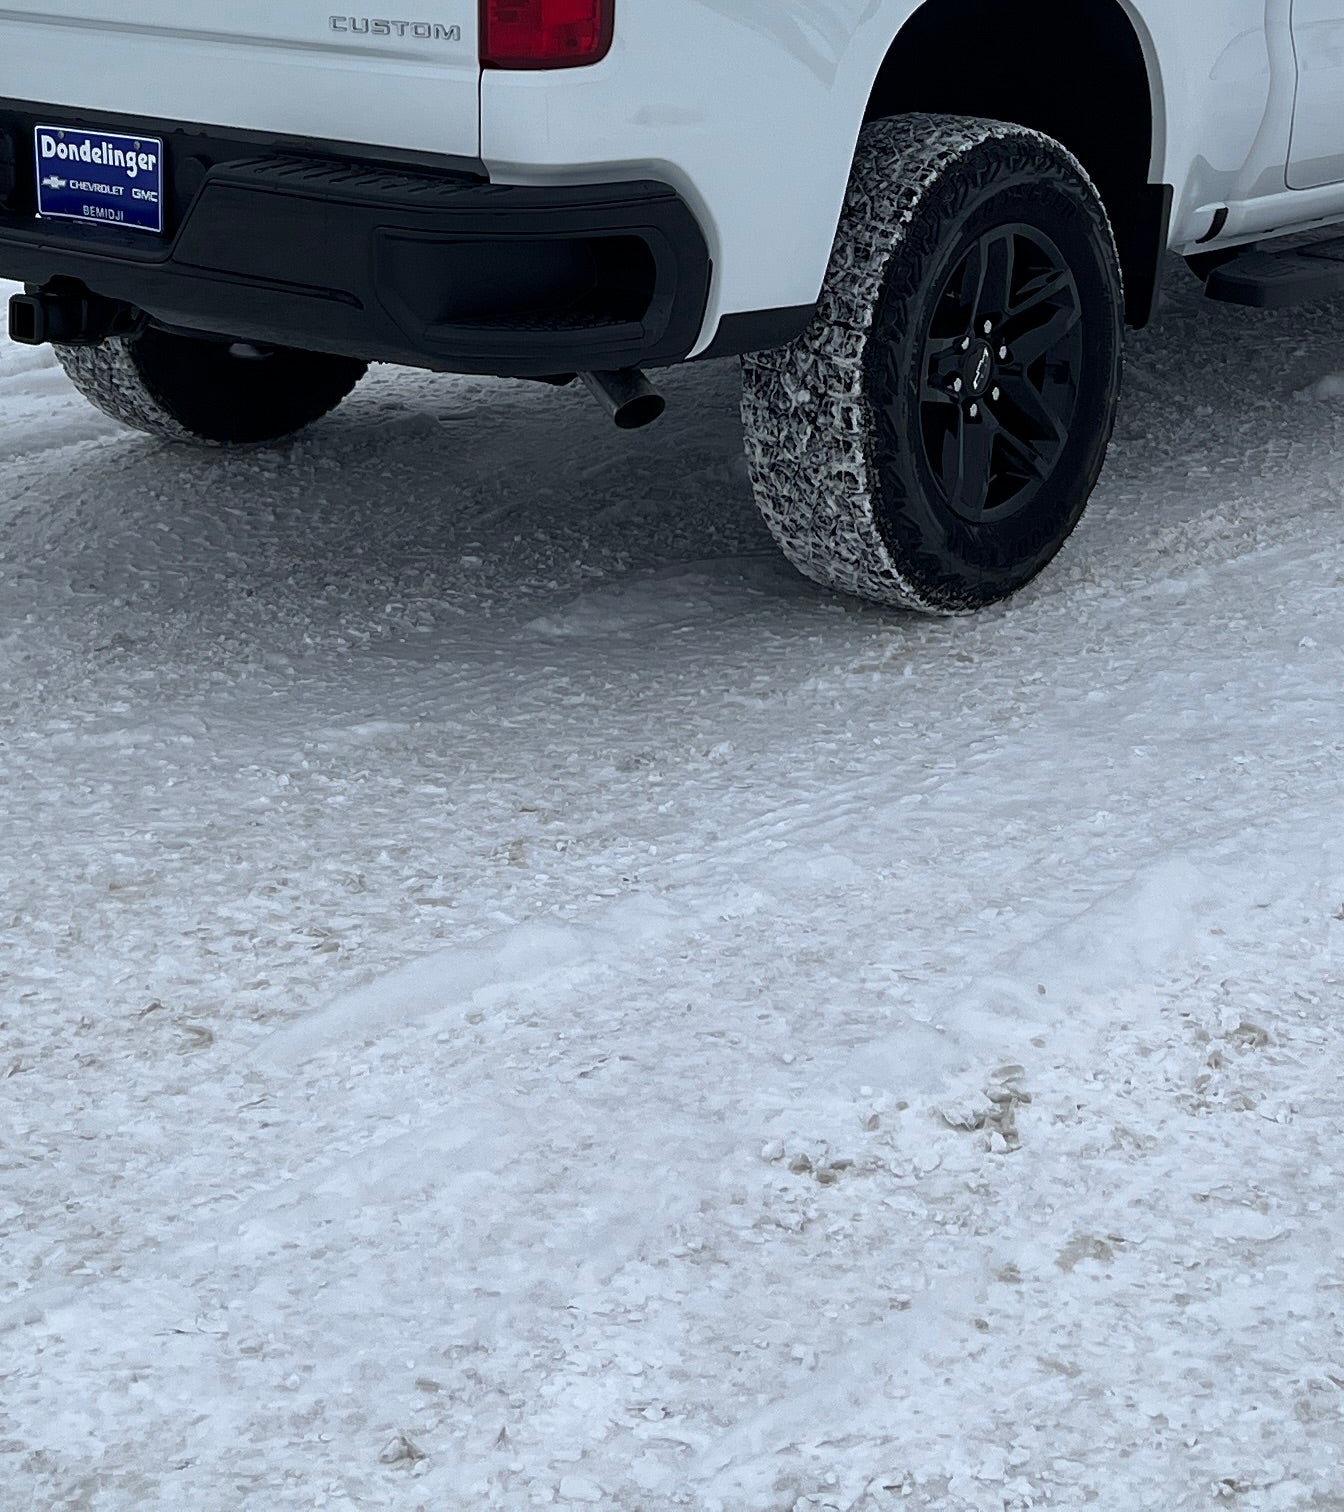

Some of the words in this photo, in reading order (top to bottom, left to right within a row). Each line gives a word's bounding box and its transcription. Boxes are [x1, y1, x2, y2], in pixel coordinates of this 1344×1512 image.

[328, 15, 461, 41] CUSTOM
[40, 134, 157, 178] Dondelinger
[69, 179, 125, 196] CHEVROLET
[131, 188, 159, 202] GMC
[82, 204, 124, 221] BEMIDJI
